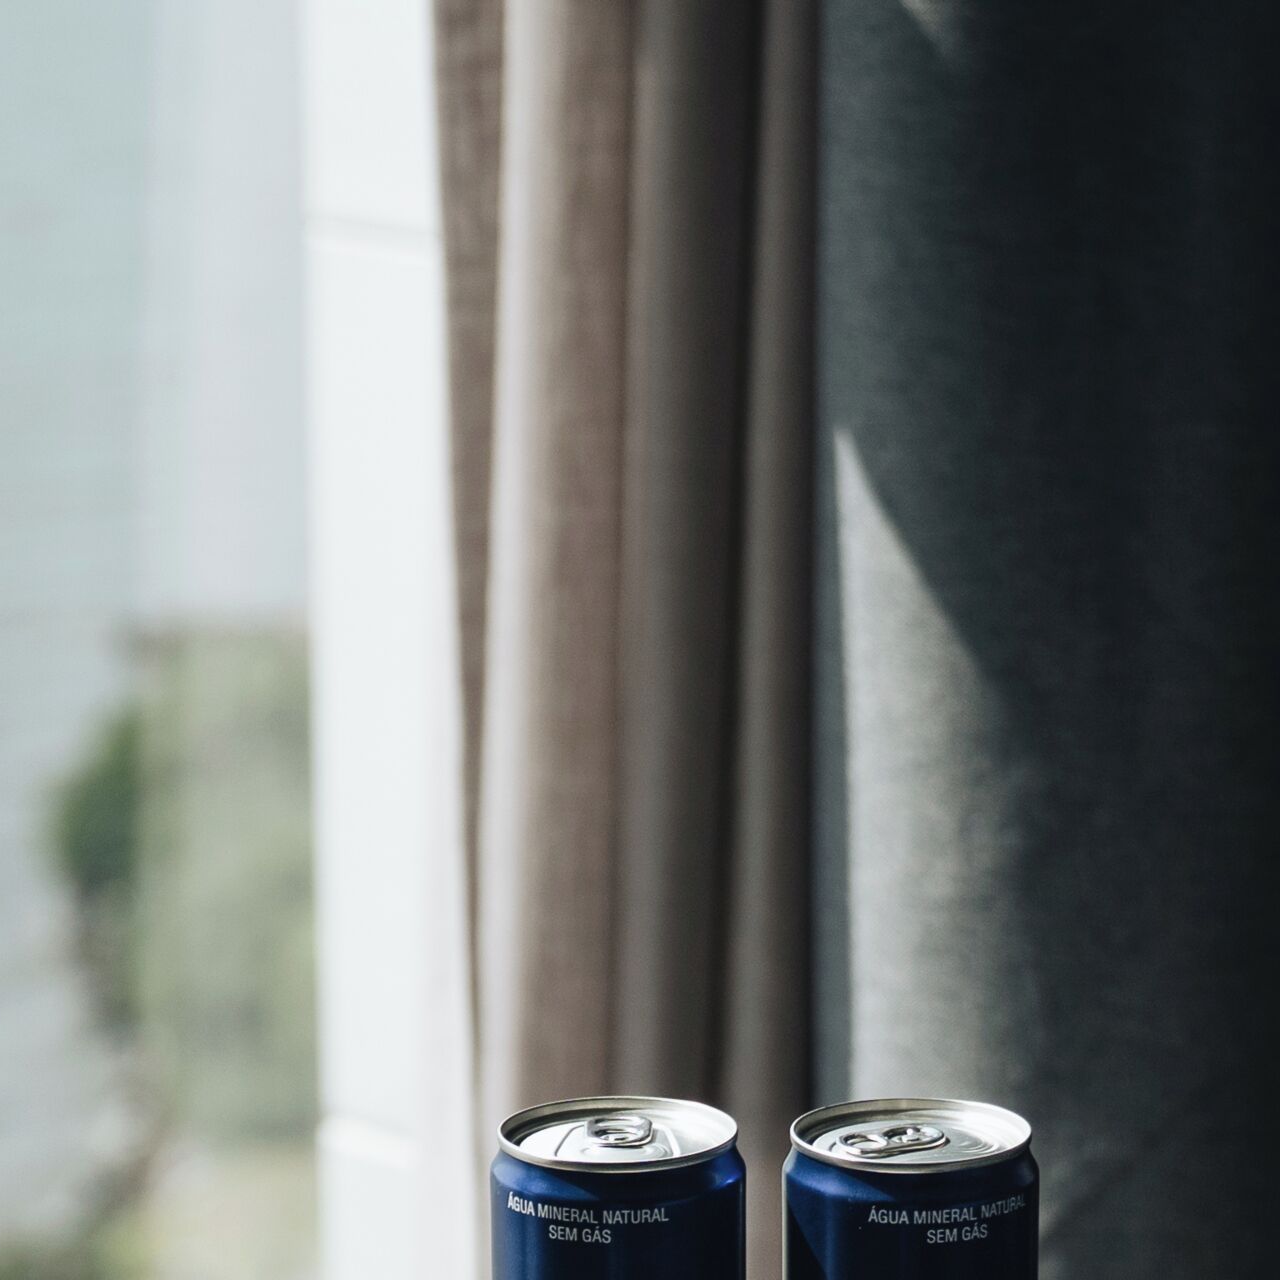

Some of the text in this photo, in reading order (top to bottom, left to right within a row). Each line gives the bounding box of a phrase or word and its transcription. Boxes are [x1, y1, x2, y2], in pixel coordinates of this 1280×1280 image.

[507, 1191, 670, 1224] ÁGUA MINERAL NATURAL
[868, 1194, 1027, 1225] ÁGUA MINERAL NATURAL
[548, 1224, 612, 1244] SEM GÁS
[926, 1223, 988, 1244] SEM GÁS
